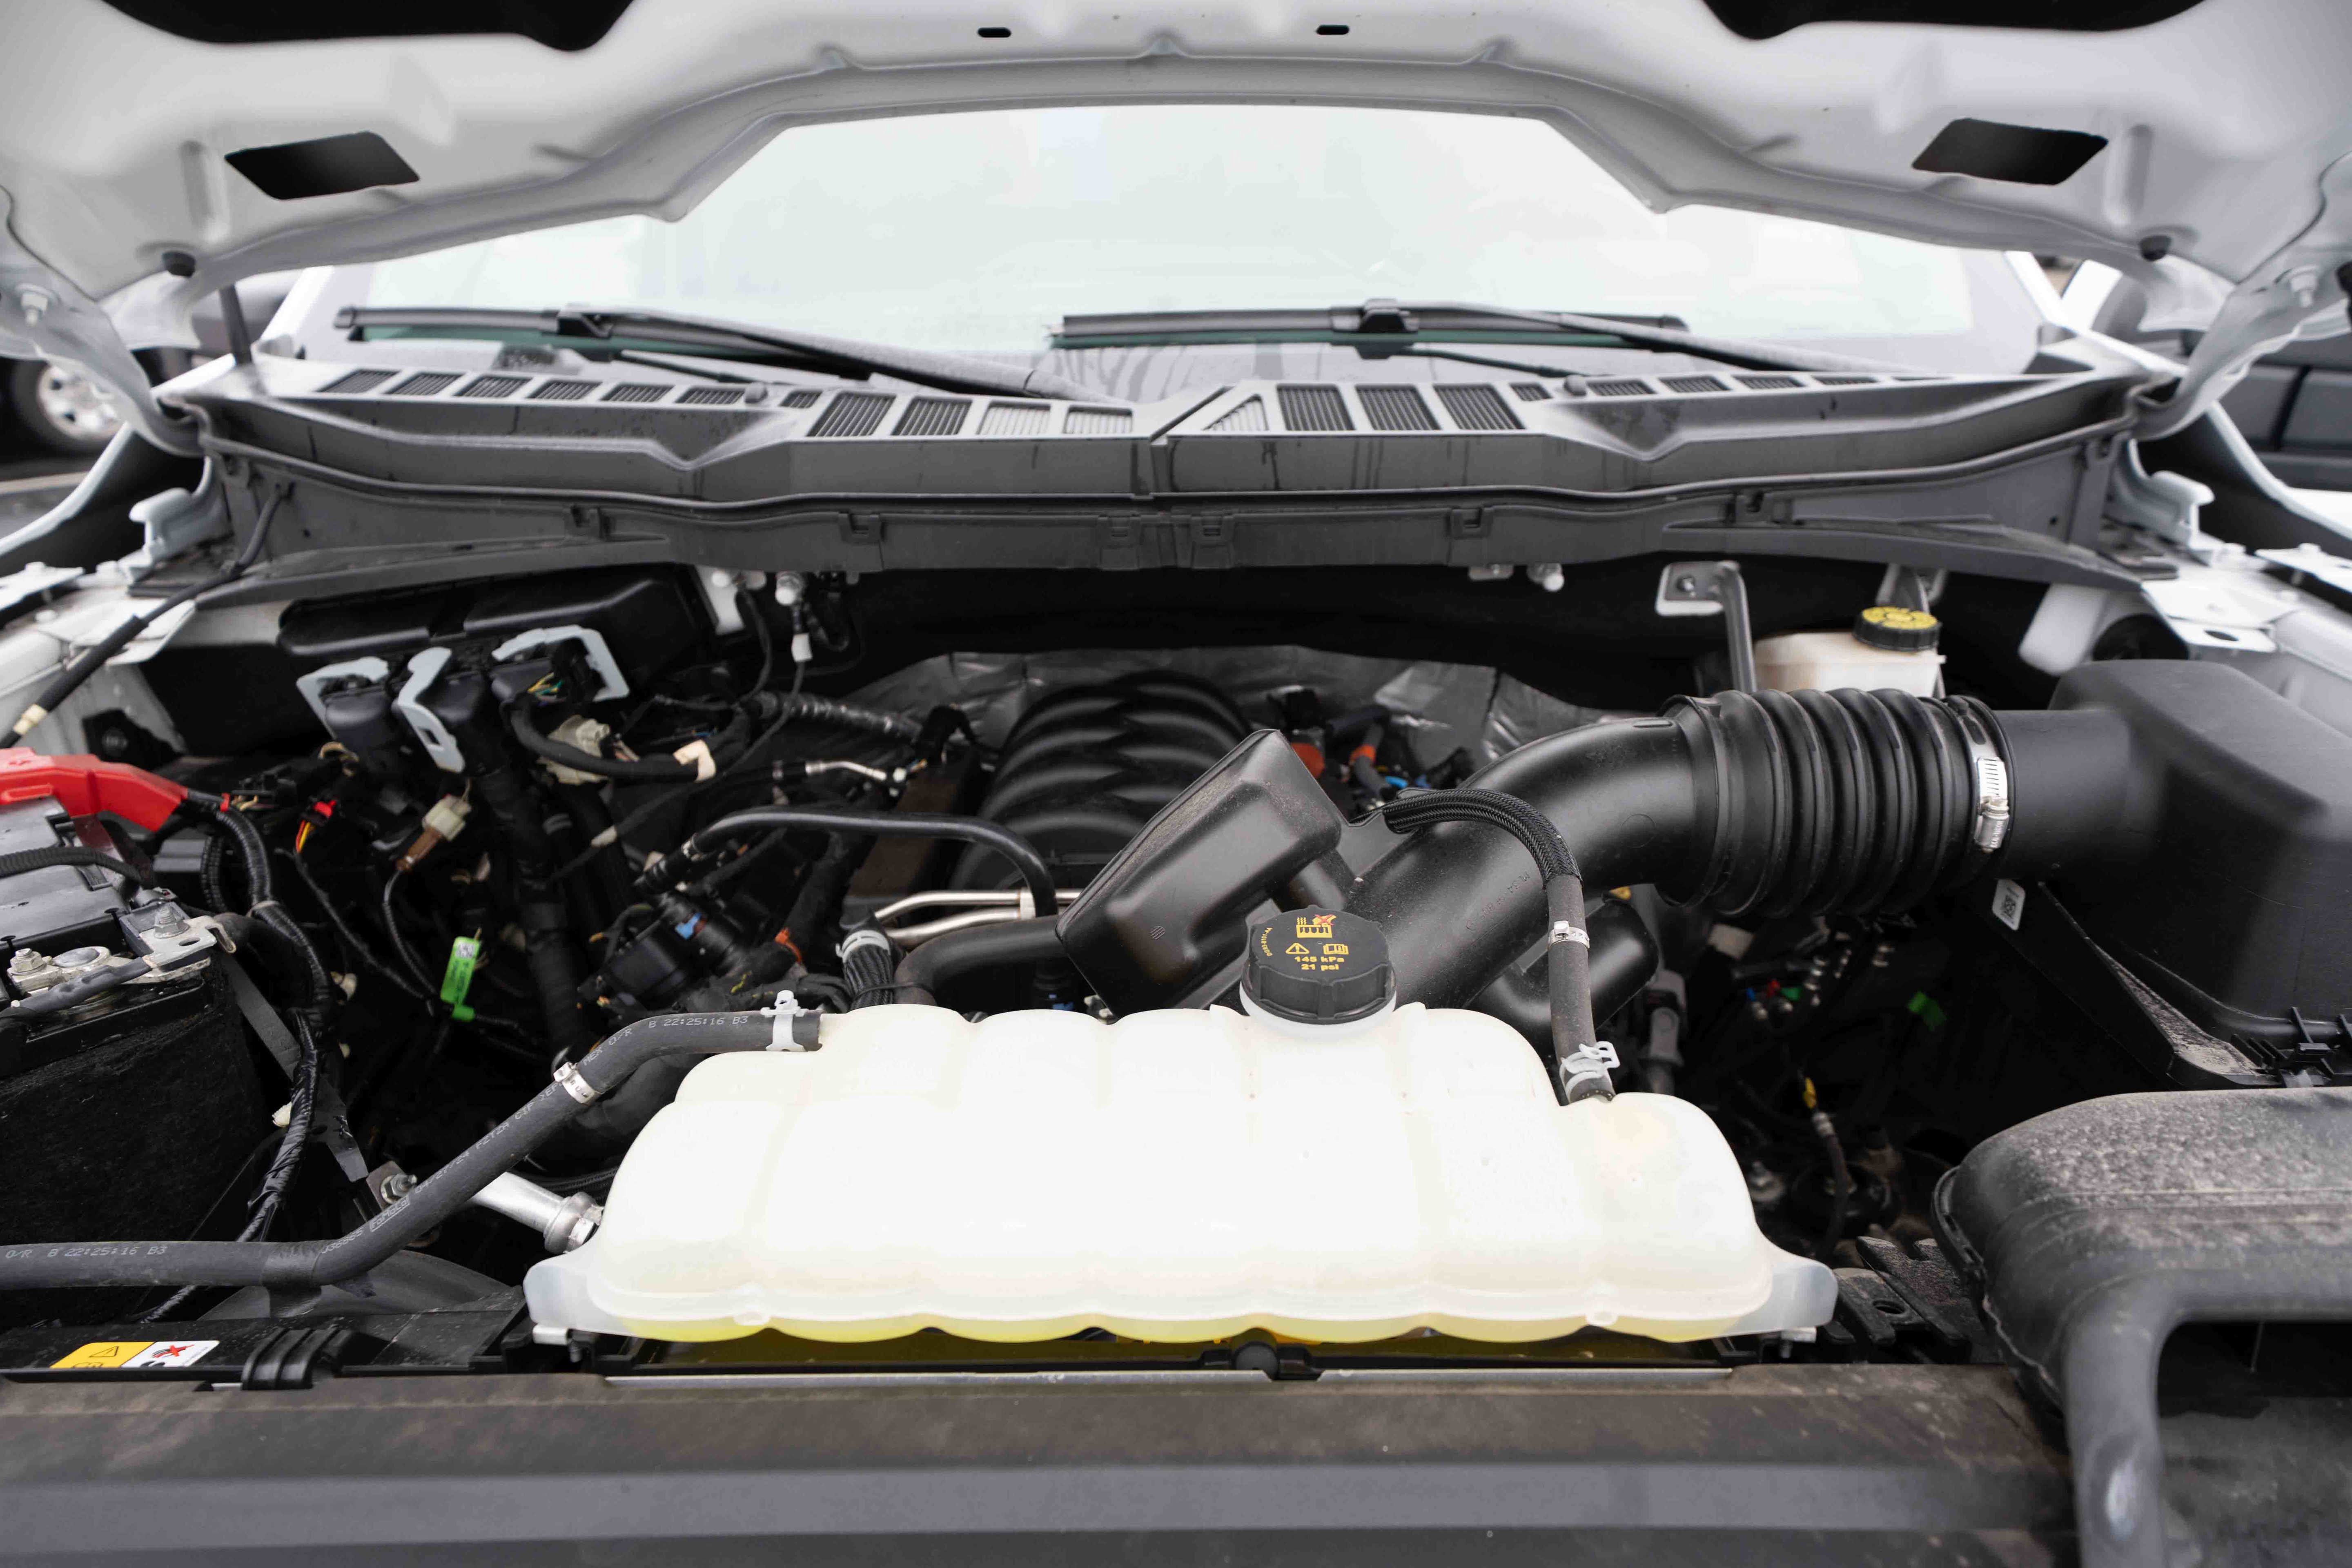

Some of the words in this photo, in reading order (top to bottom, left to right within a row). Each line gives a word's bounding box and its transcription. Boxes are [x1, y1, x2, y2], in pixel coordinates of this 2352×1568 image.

[648, 1020, 656, 1029] B
[663, 1017, 724, 1027] 22:25:16
[732, 1016, 749, 1025] B3
[47, 1248, 60, 1258] B
[64, 1246, 140, 1257] 22:25:16
[147, 1246, 168, 1255] B3
